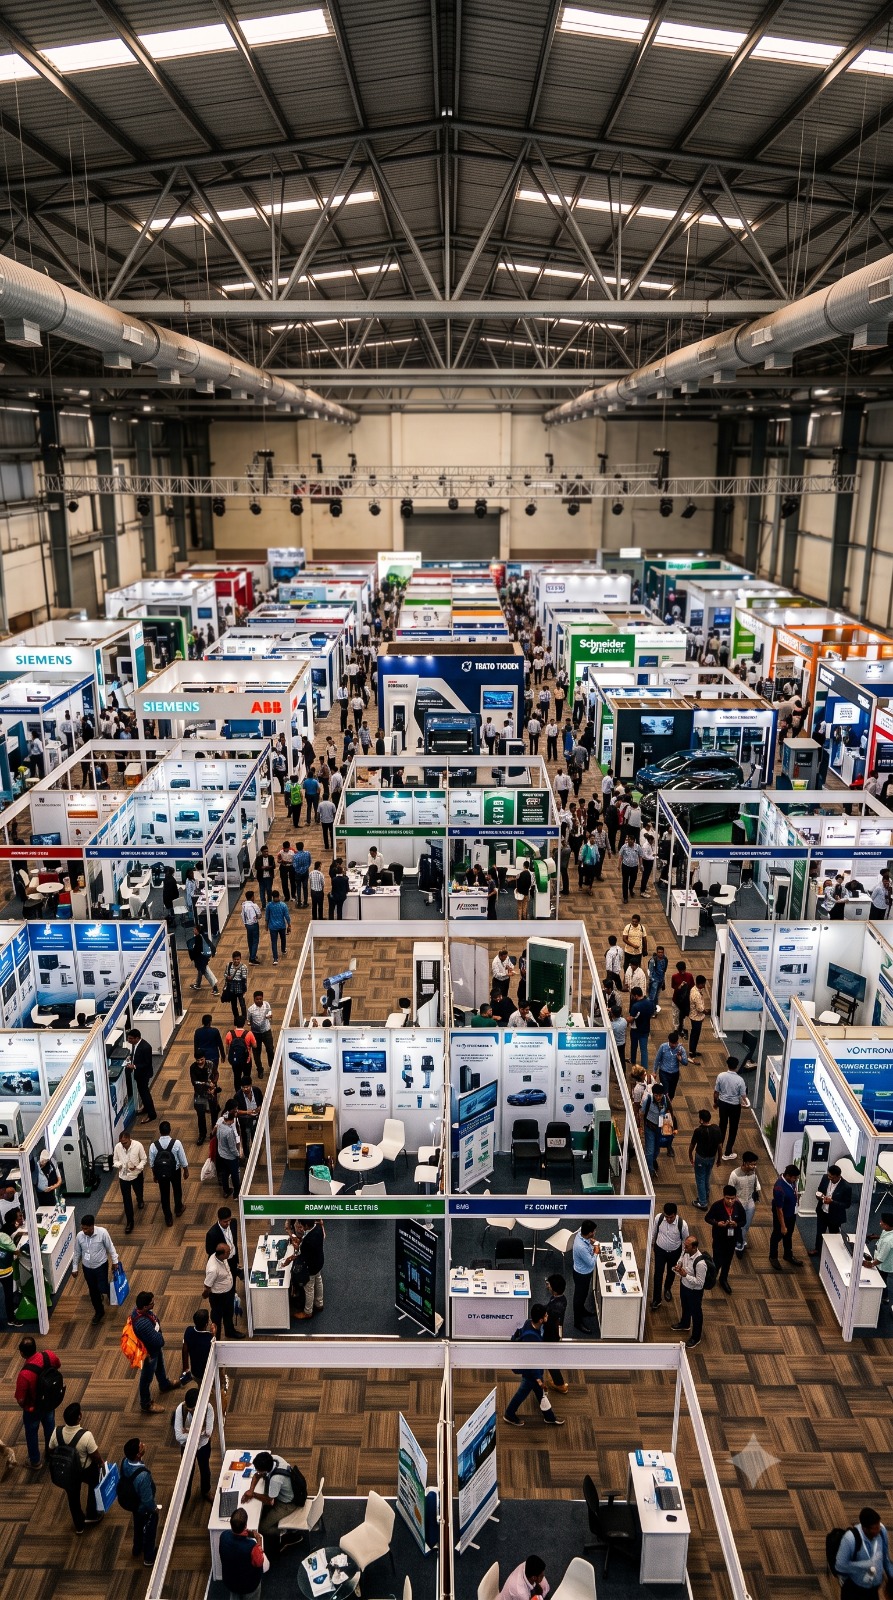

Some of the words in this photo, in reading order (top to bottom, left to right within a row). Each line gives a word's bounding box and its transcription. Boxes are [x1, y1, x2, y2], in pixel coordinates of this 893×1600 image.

[579, 639, 626, 654] Schneider
[16, 655, 73, 665] SIEMENS
[143, 701, 200, 712] SIEMENS
[251, 701, 282, 714] ABB
